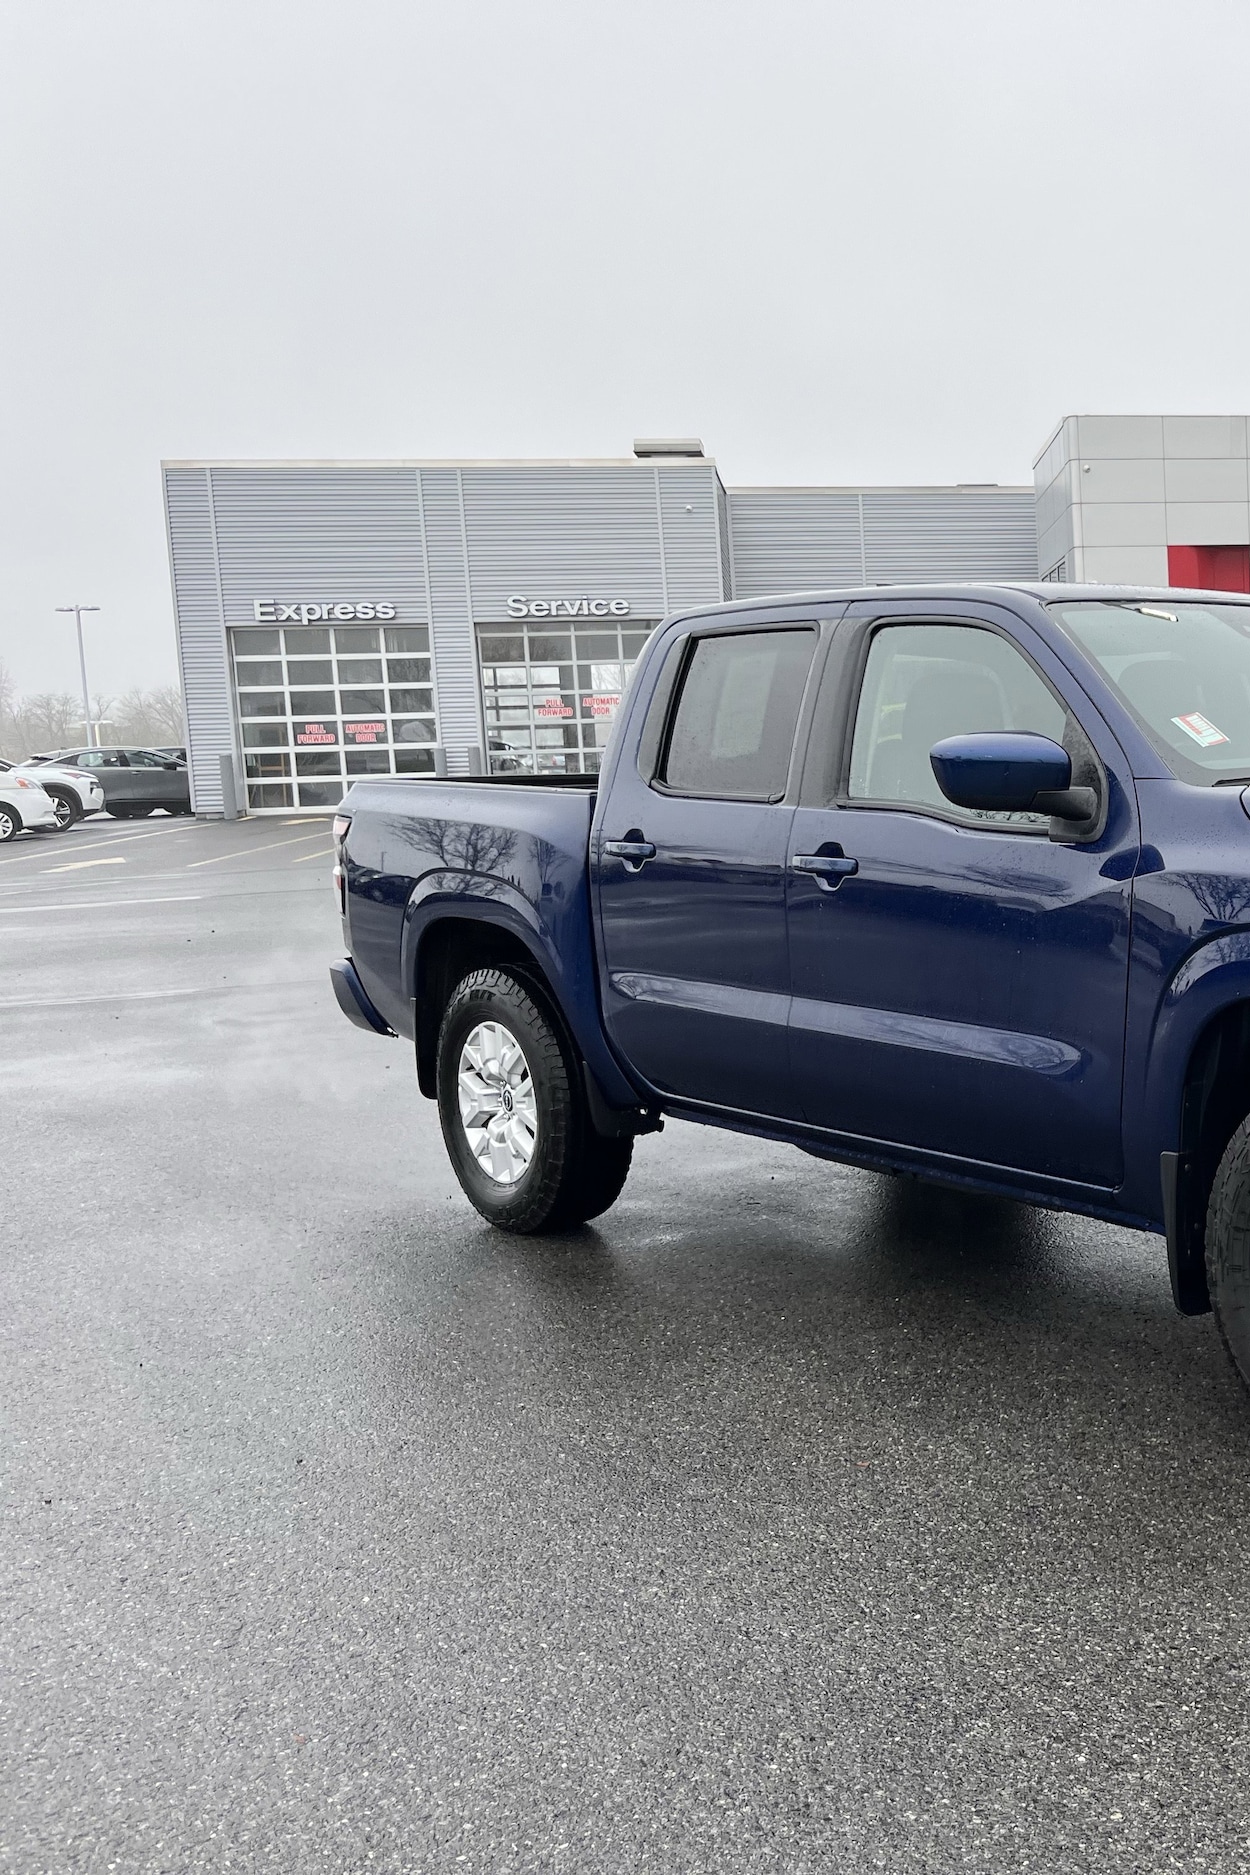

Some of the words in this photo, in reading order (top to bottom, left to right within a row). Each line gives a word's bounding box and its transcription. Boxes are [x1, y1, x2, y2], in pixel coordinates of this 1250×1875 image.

[506, 595, 630, 618] Service
[253, 599, 397, 626] Express
[545, 698, 565, 708] PULL
[582, 697, 620, 707] AUTOMATIC
[537, 707, 573, 717] FORWARD
[591, 707, 610, 716] DOOR
[305, 724, 326, 734] PULL
[345, 723, 386, 733] AUTOMATIC
[297, 734, 336, 744] FORWARD
[356, 733, 377, 743] DOOR
